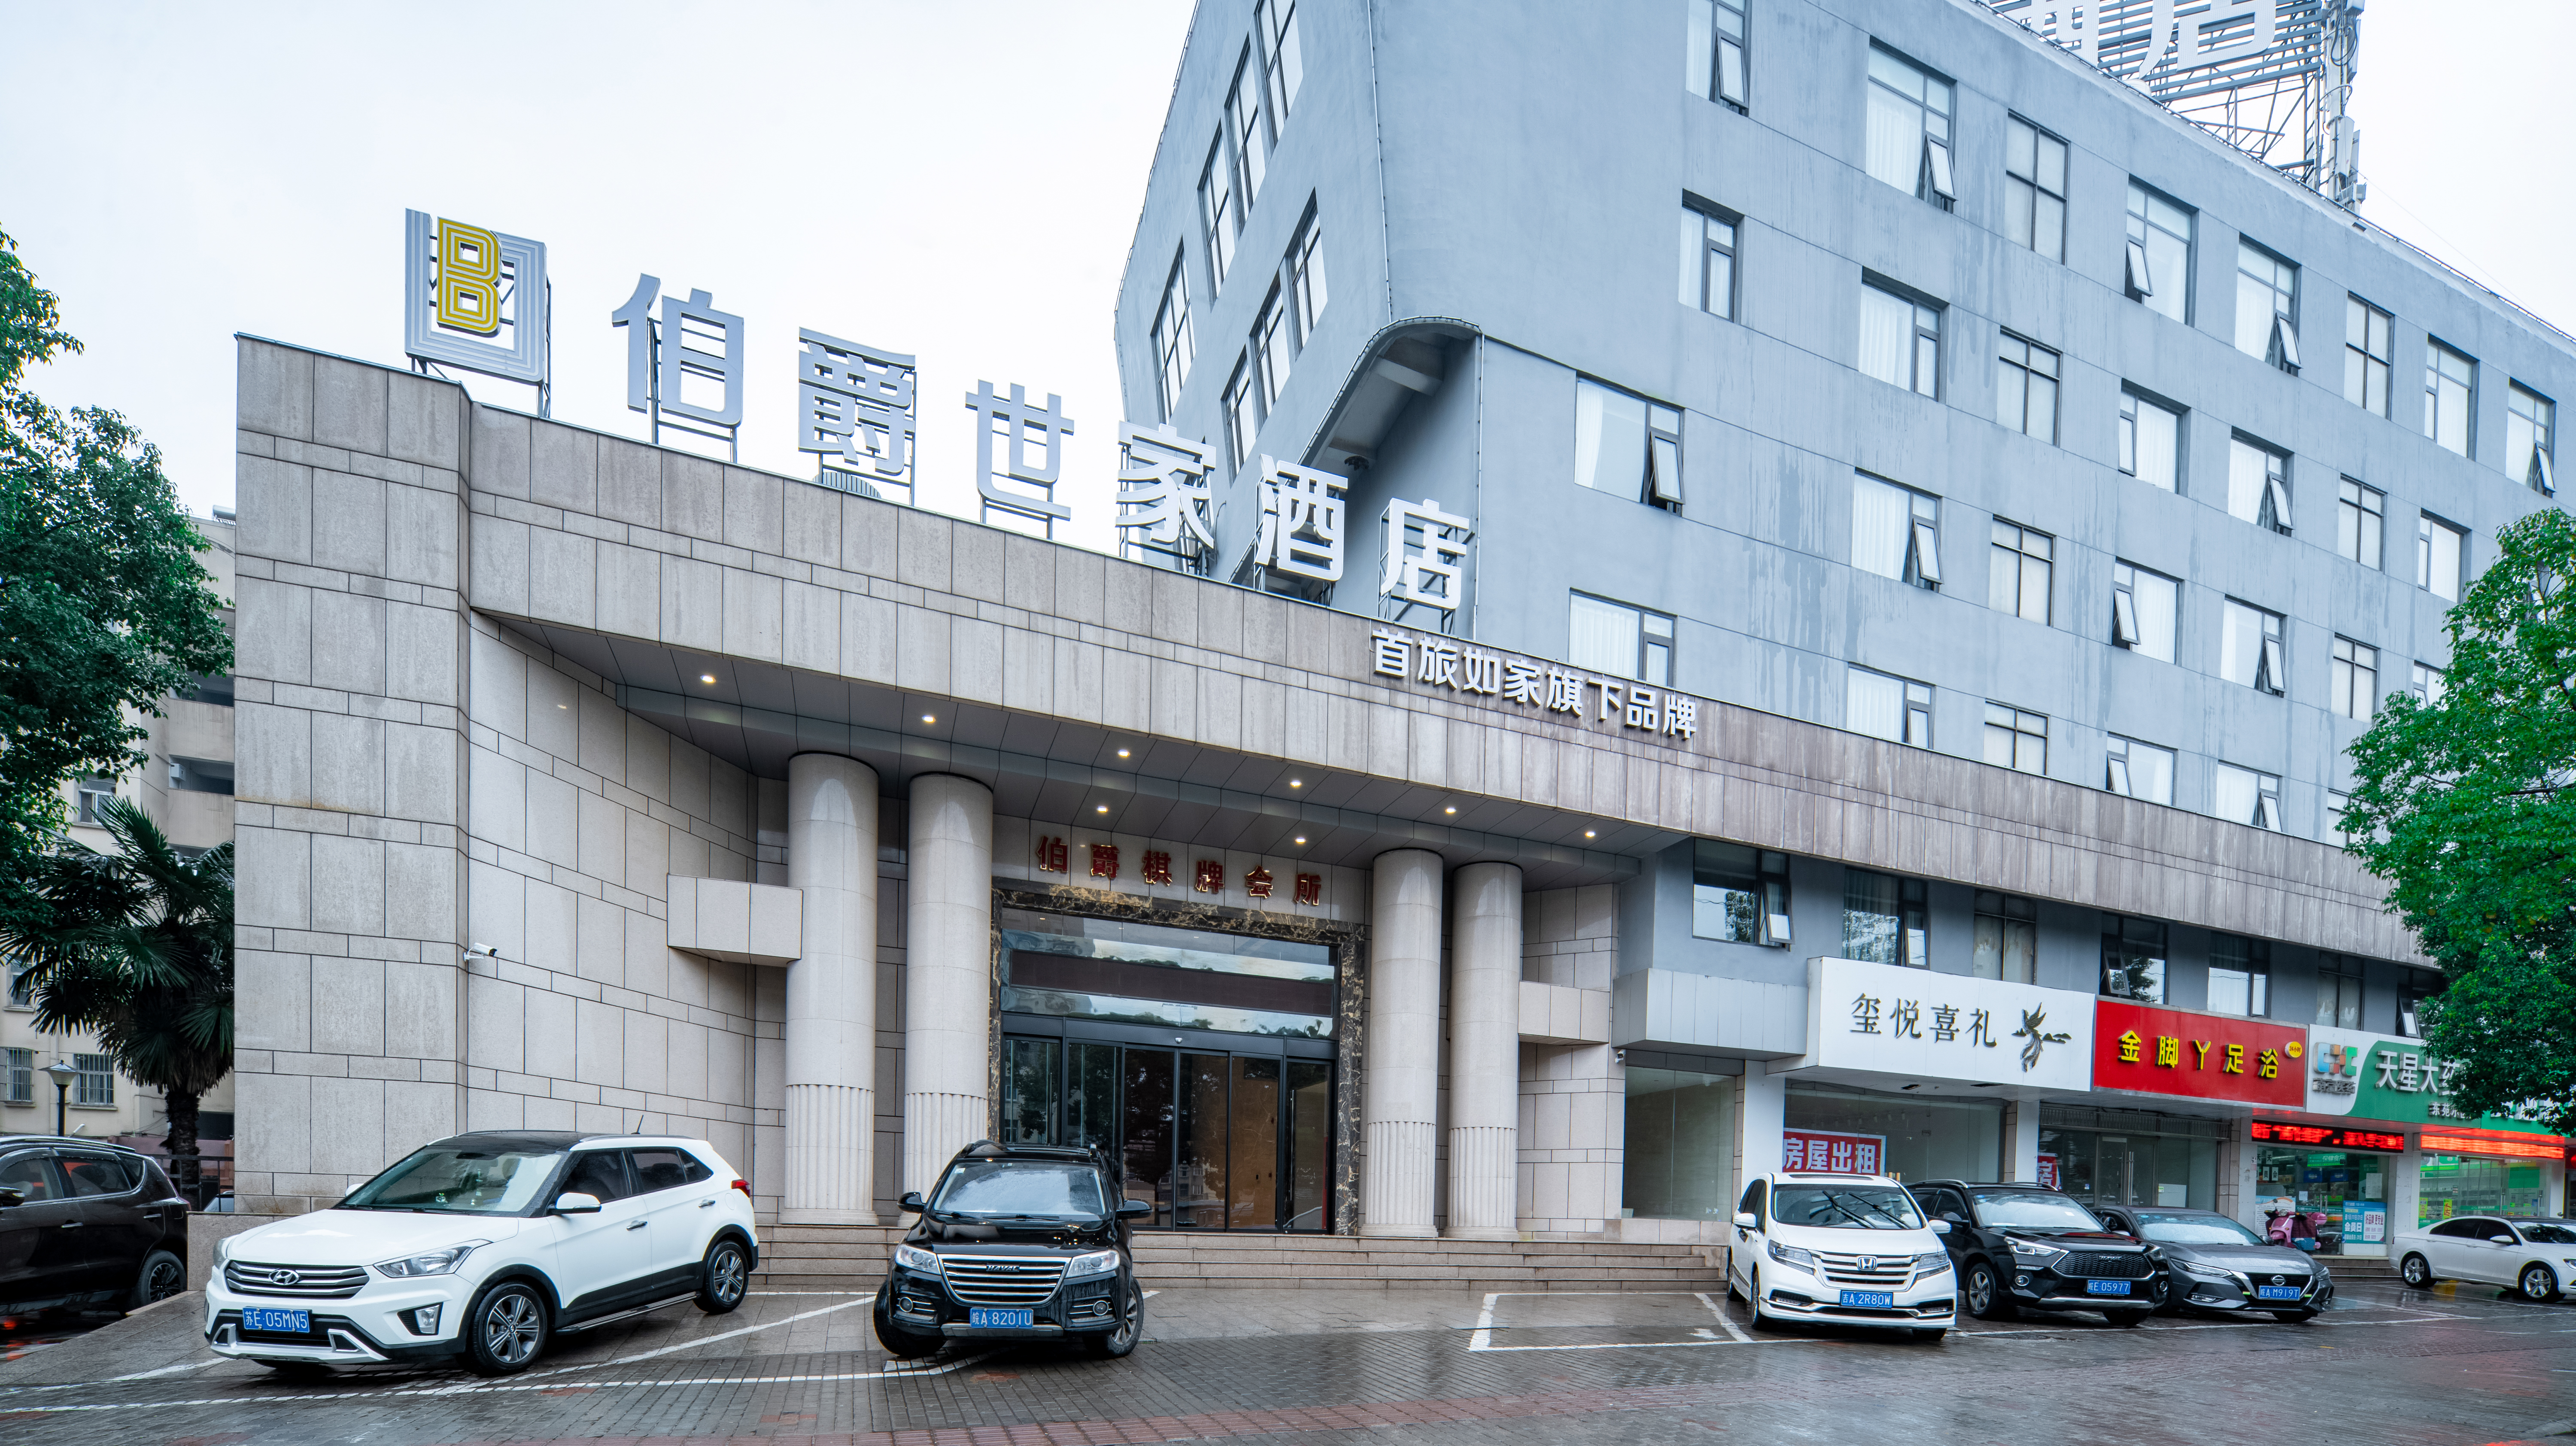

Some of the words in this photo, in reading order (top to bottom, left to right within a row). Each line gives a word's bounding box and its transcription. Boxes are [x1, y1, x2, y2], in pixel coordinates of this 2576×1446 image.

[611, 273, 1471, 610] 伯爵世家酒店
[1371, 628, 1698, 739] 首旅如家旗下品牌
[1036, 835, 1322, 906] 伯爵棋牌会所
[1850, 992, 1997, 1048] 玺悦喜礼
[2117, 1030, 2279, 1079] 金脚丫足浴
[1783, 1137, 1876, 1174] 房屋出租
[2345, 1221, 2362, 1233] 会员日
